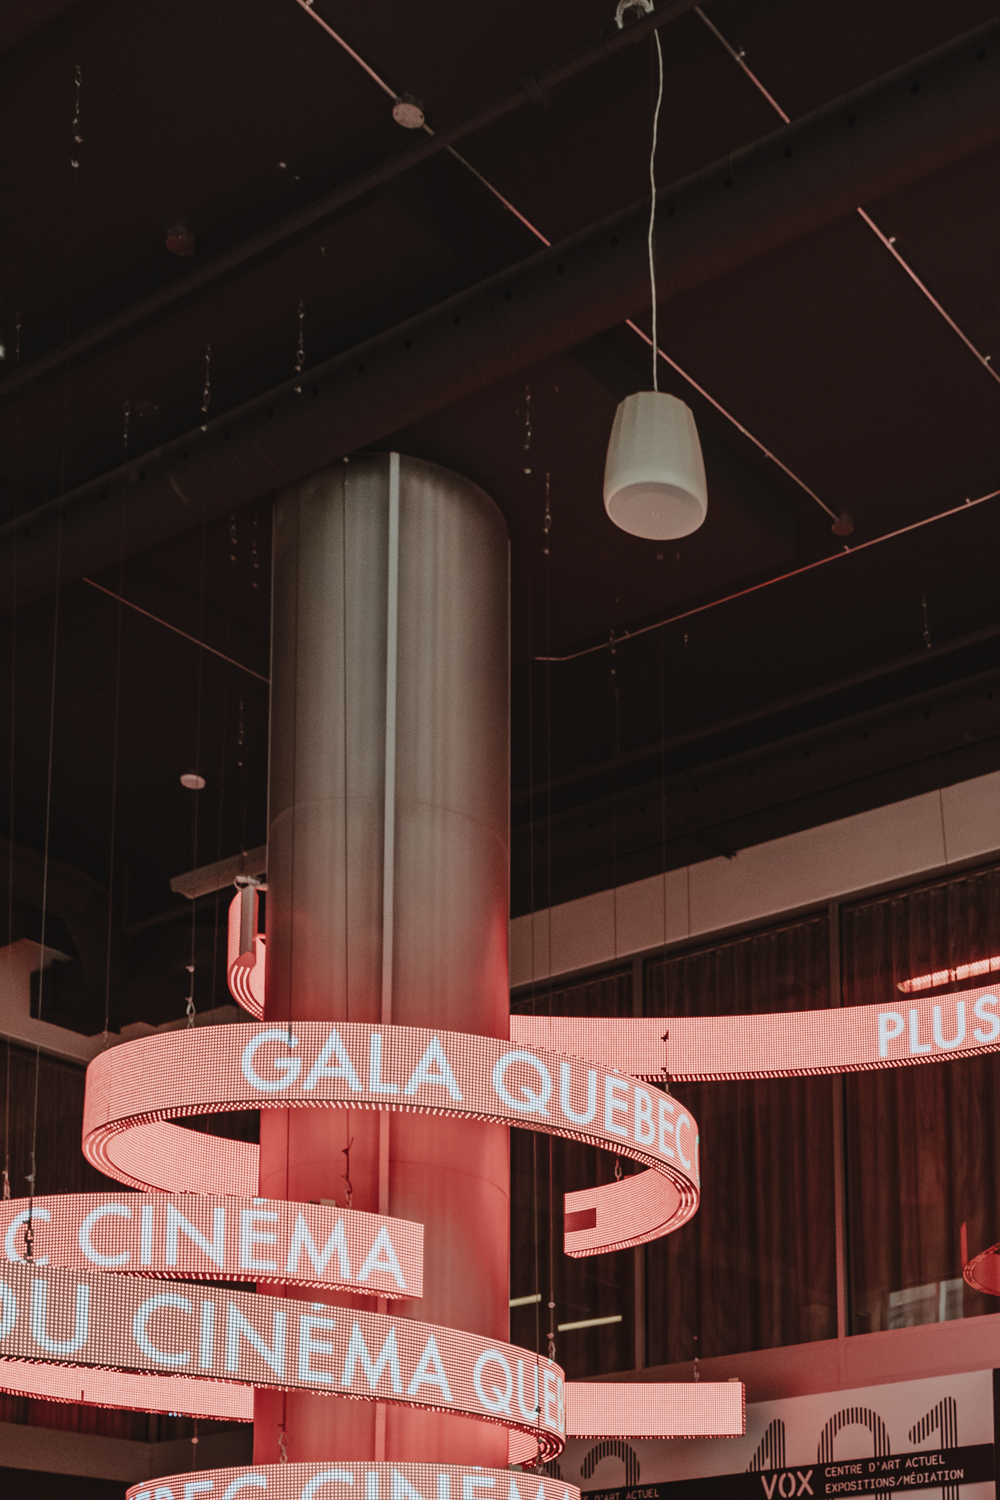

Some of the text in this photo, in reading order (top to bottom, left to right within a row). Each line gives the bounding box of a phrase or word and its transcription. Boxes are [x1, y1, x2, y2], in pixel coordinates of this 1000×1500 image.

[877, 995, 1000, 1058] PLUS
[242, 1029, 463, 1102] GALA
[825, 1455, 946, 1477] CENTRE D'ART ACTUEL
[626, 1489, 660, 1500] ACTUEL
[761, 1469, 814, 1500] VOX
